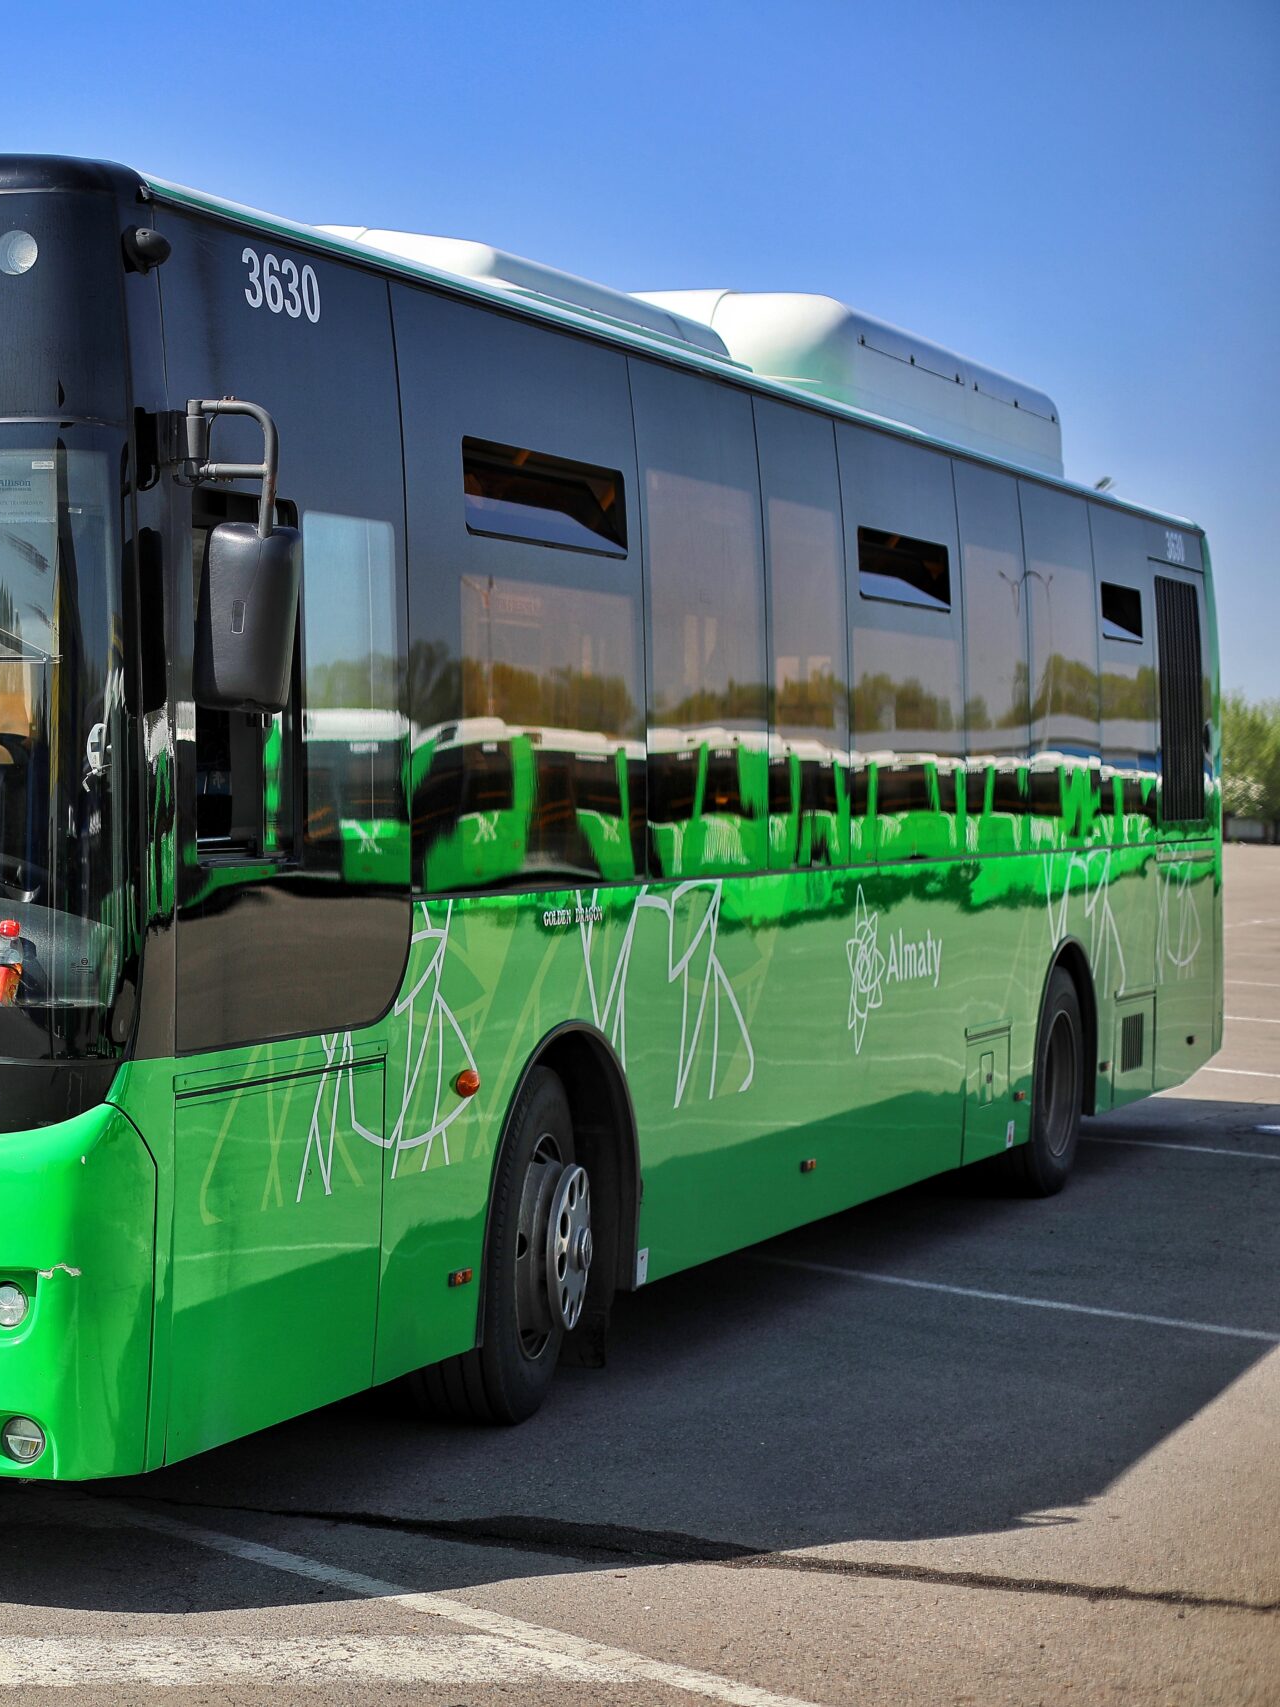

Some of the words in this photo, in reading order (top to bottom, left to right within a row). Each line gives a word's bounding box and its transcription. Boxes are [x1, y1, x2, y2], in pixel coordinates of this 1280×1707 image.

[241, 247, 321, 323] 3630
[543, 909, 571, 926] GOLDEN
[575, 906, 603, 923] DRAGON
[886, 928, 942, 988] Almaty
